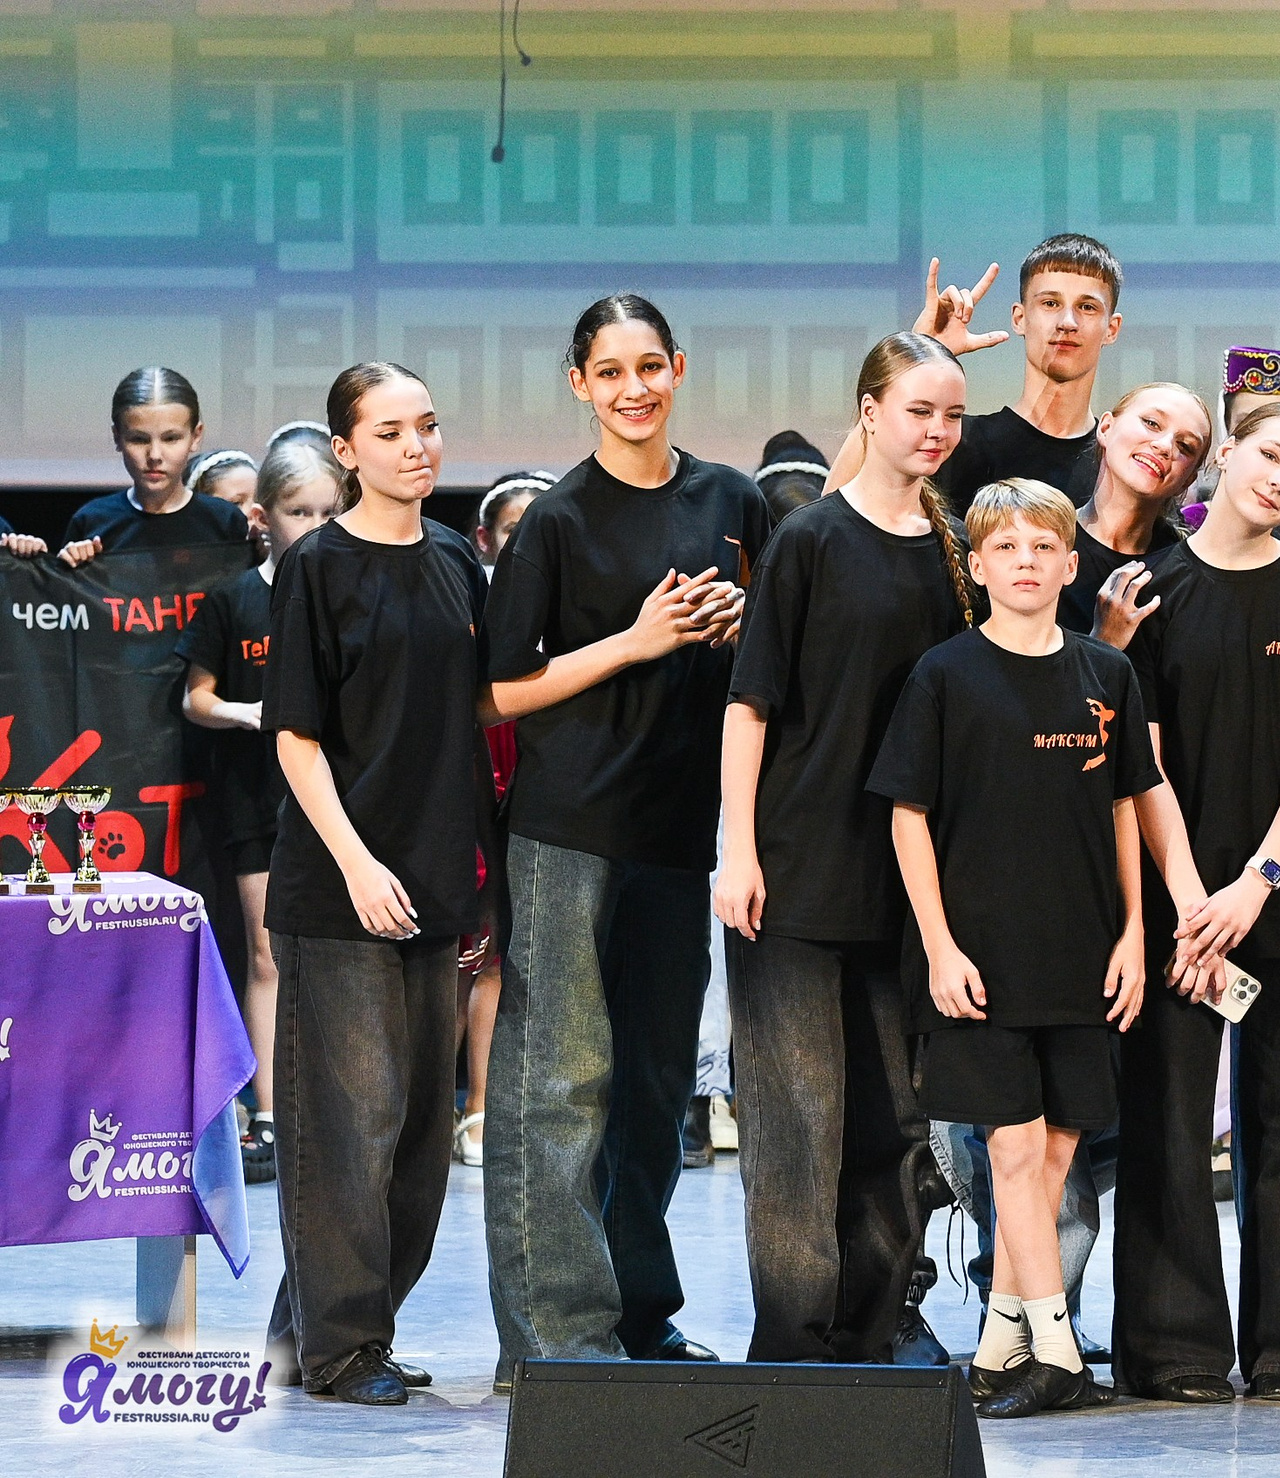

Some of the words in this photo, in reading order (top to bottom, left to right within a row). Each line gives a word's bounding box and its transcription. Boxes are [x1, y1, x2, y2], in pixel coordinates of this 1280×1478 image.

[13, 603, 89, 630] чем
[1033, 733, 1097, 749] МАКСИМ
[95, 915, 178, 931] FESTRUSSIA.RU
[131, 1131, 178, 1141] ФЕСТИВАЛИ
[123, 1140, 177, 1150] ЮНОШЕСКОГО
